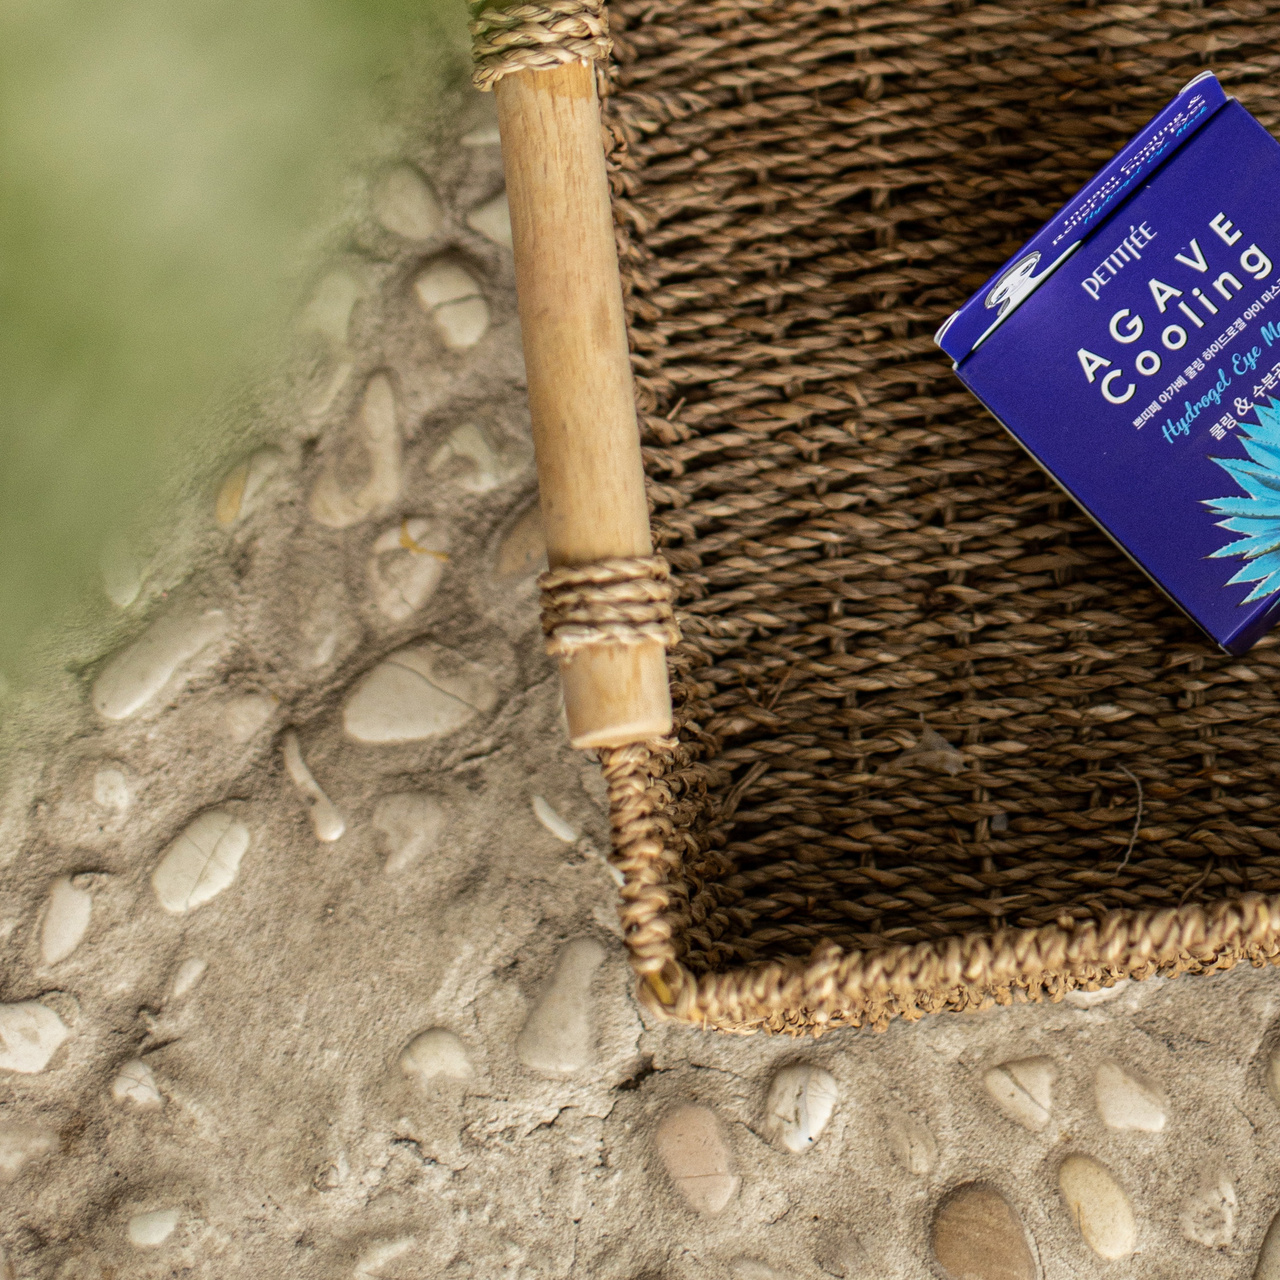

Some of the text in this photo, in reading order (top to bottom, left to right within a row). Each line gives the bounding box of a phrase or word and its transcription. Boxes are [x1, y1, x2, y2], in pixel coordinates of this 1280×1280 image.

[1052, 100, 1206, 246] Relief for Puffy Eyes
[1064, 94, 1203, 226] Instant Cooling &
[1077, 212, 1243, 383] AGAVE
[1101, 243, 1274, 405] Cooling
[1132, 400, 1162, 430] 쁘띠페
[1158, 375, 1188, 403] 아가베
[1183, 357, 1206, 379] 쿨링
[1202, 317, 1247, 361] 하이드로겔
[1243, 300, 1265, 320] 아이
[1161, 368, 1231, 443] Hydrogel
[1231, 346, 1262, 375] Eye
[1209, 412, 1238, 441] 쿨링
[1233, 397, 1254, 416] &
